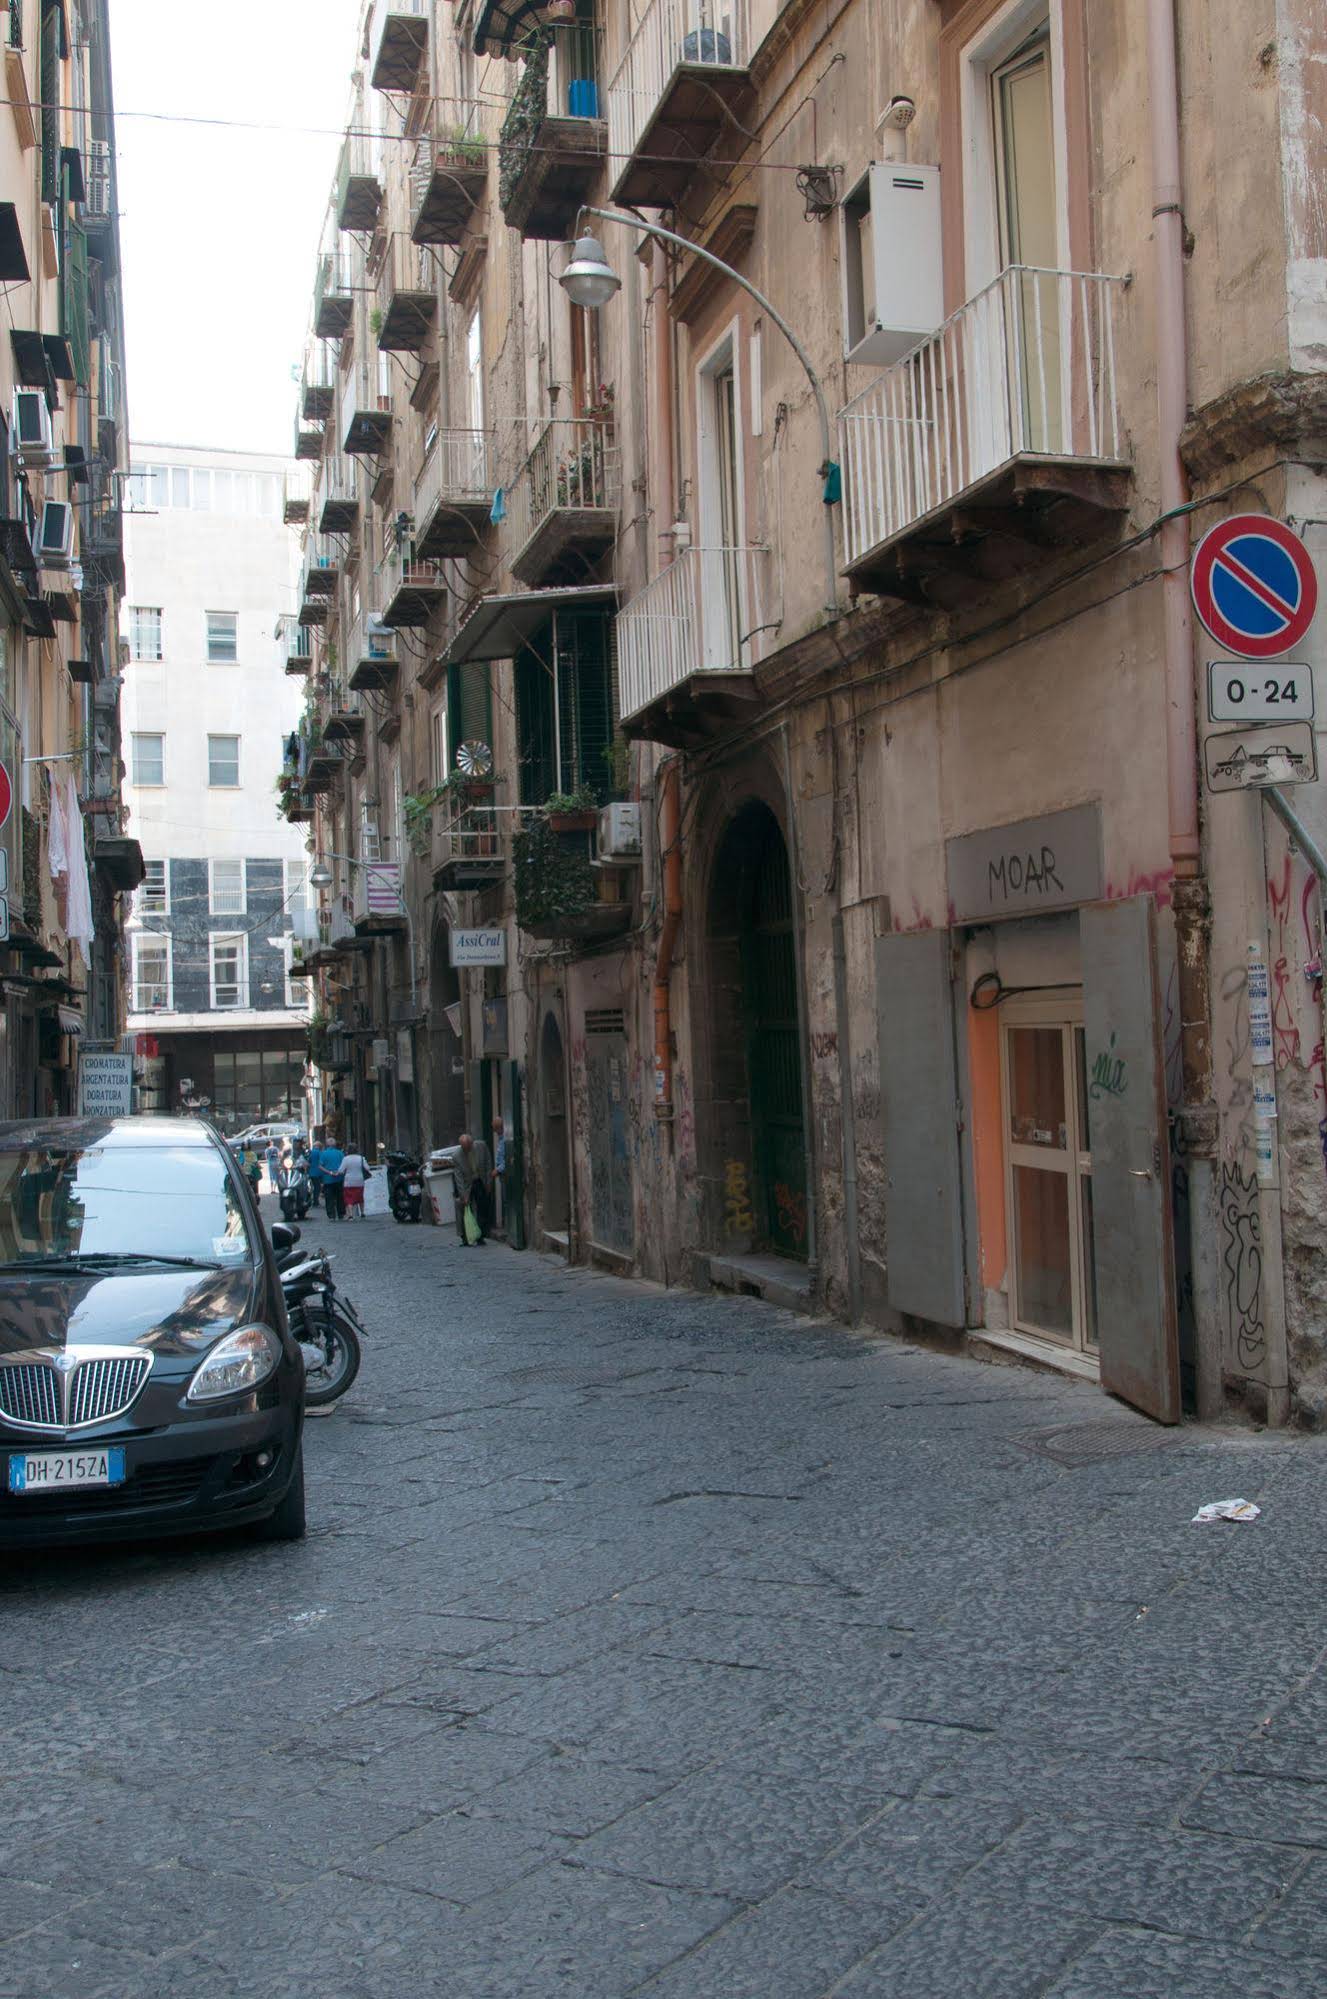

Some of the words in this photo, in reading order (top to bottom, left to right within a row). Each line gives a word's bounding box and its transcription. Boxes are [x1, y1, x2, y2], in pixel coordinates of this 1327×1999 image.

[988, 846, 1064, 902] MOAR
[84, 1058, 126, 1069] CROMATURA
[81, 1074, 129, 1085] ARGENTATURA
[86, 1089, 122, 1101] DORATURA
